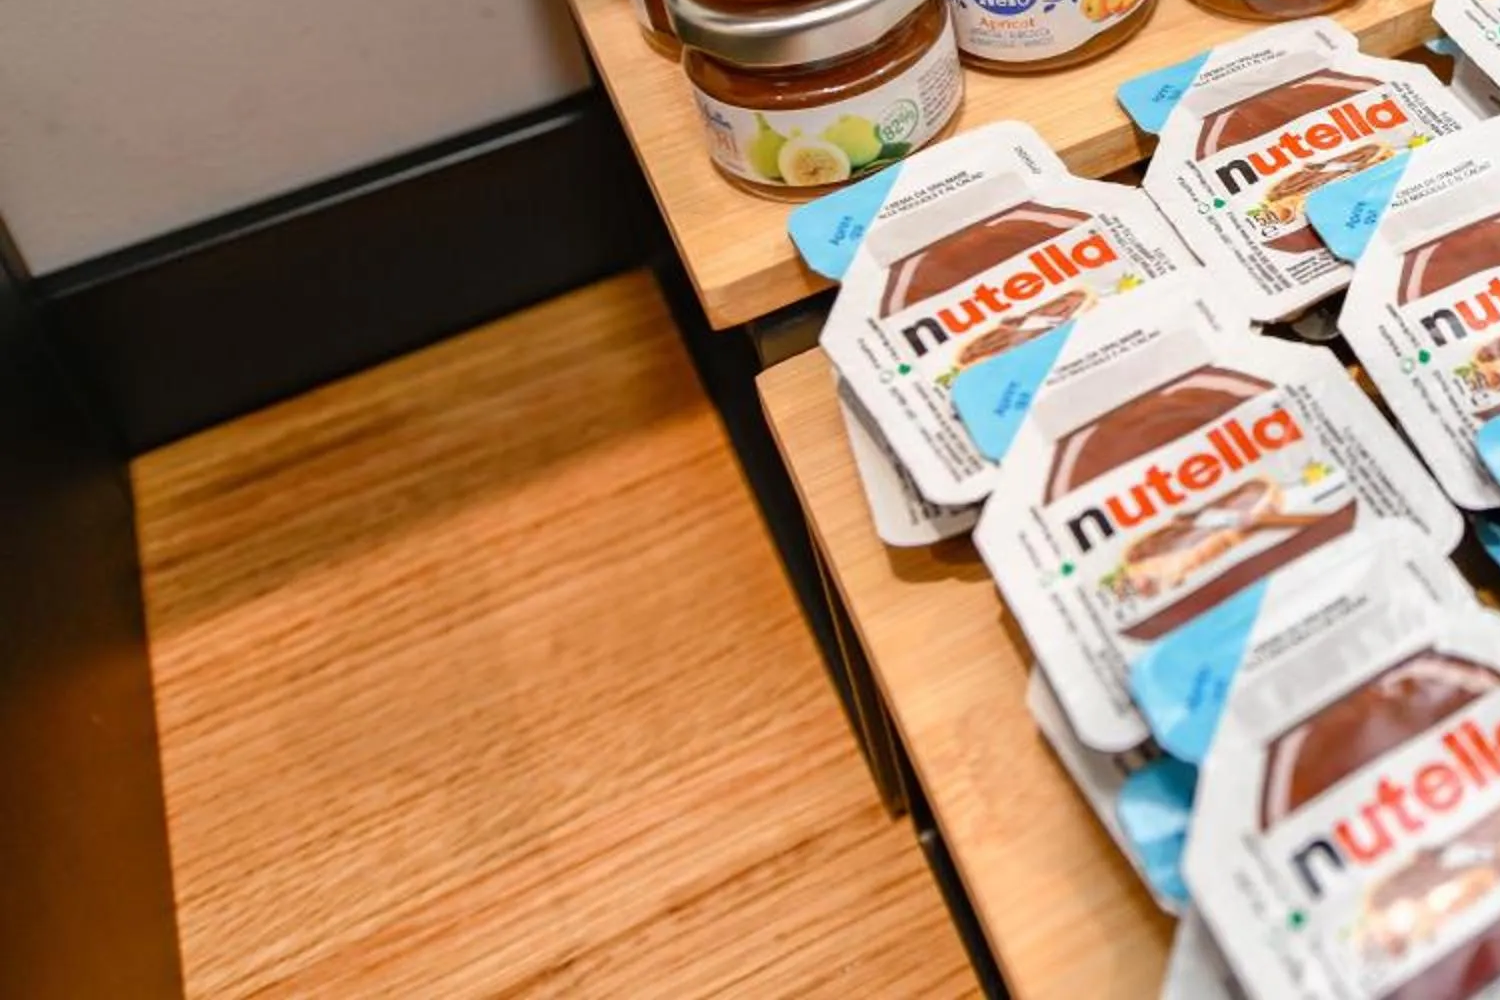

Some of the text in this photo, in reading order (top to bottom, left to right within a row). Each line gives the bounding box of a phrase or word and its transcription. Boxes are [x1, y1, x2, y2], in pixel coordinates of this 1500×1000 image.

[979, 16, 1036, 31] Apricot
[882, 109, 915, 140] 82%
[1215, 97, 1409, 196] nutella
[902, 233, 1119, 357] nutella
[1066, 407, 1304, 553] nutella
